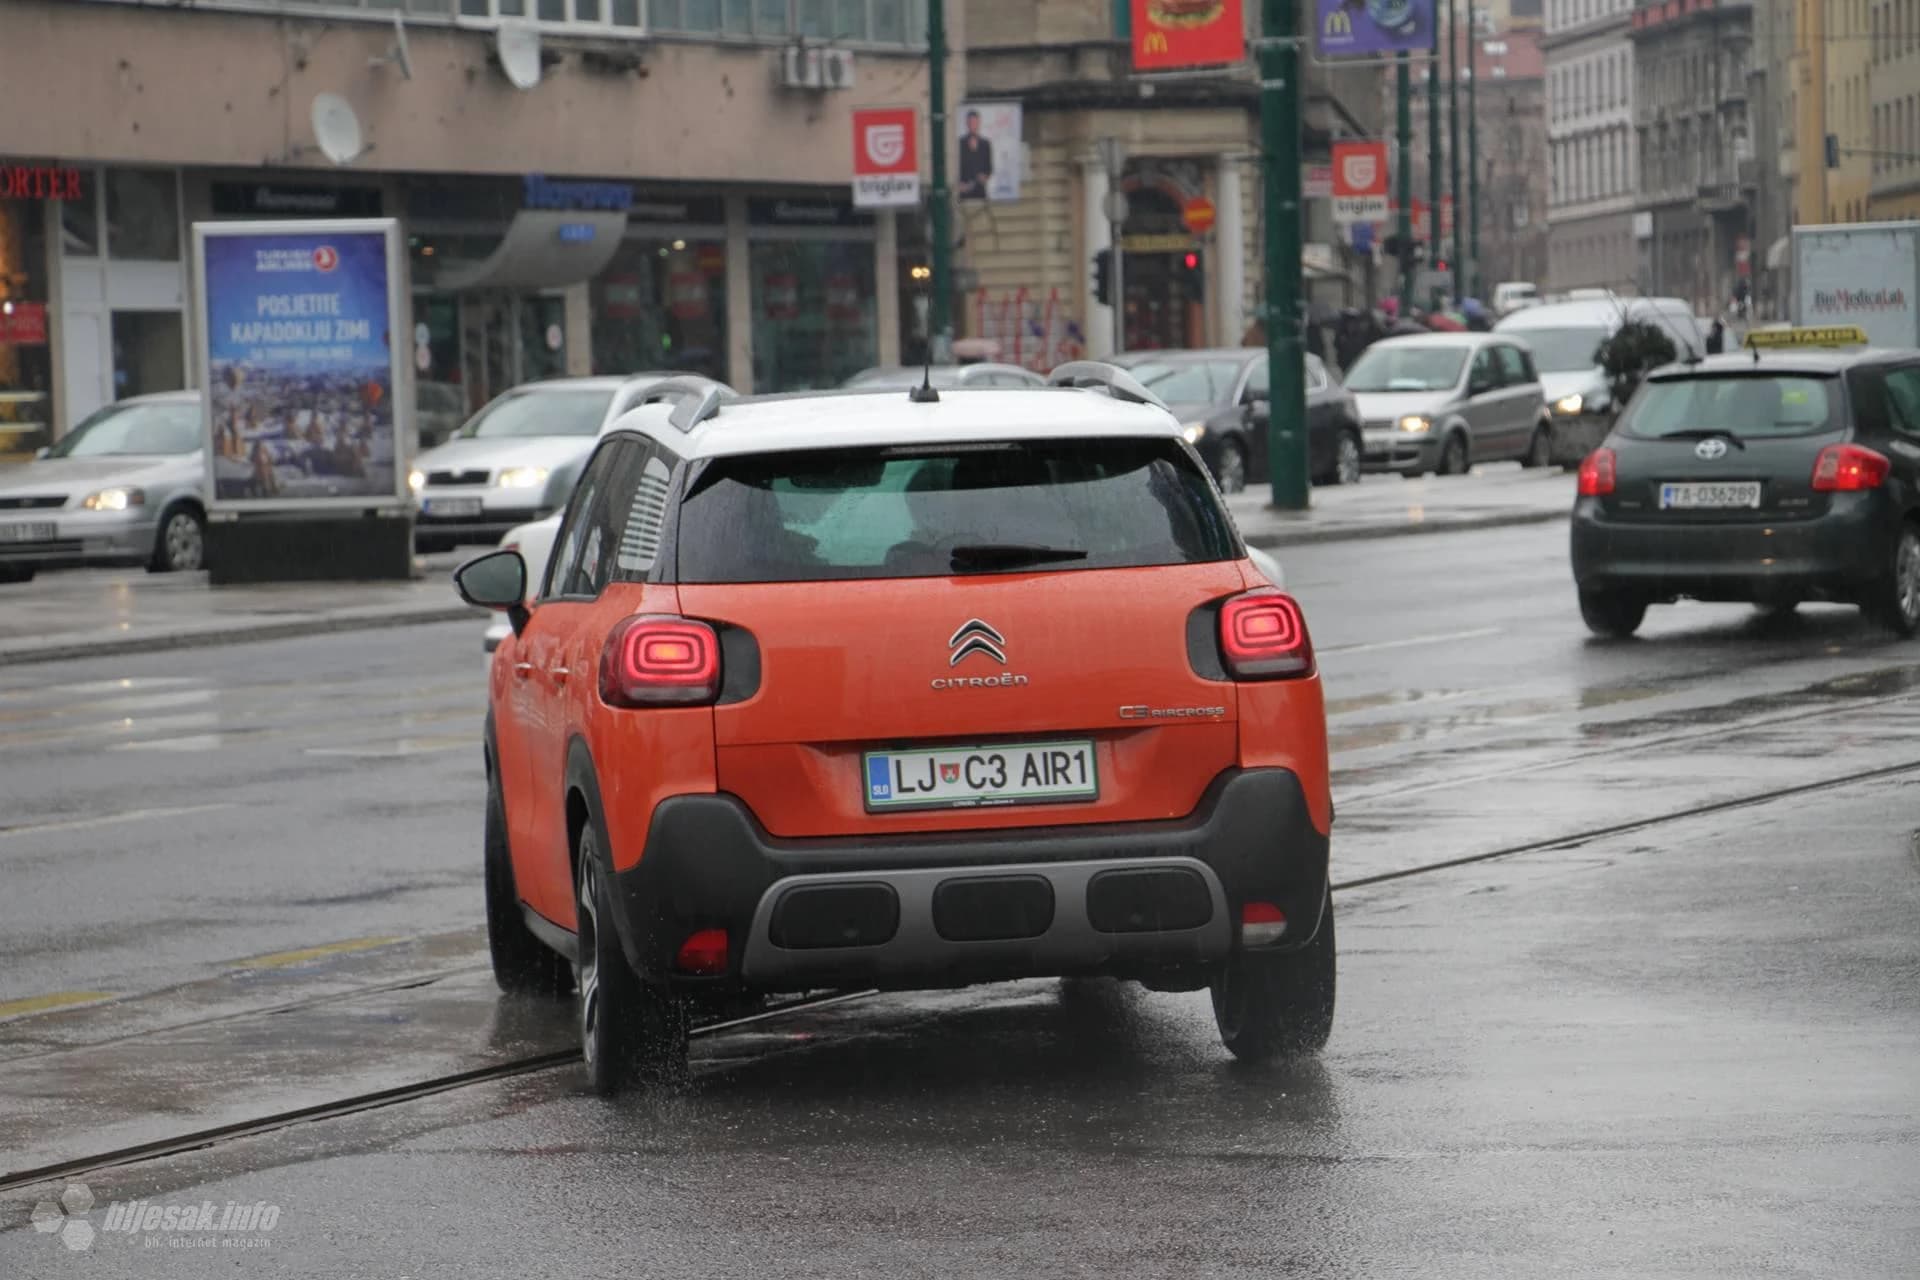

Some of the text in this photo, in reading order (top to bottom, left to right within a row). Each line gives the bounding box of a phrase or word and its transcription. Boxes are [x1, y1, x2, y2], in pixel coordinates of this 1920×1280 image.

[860, 176, 912, 197] triglav
[257, 293, 340, 317] POSJETITE
[1151, 706, 1225, 717] AIRCROSS
[895, 750, 1087, 793] LJ C3 AIR1
